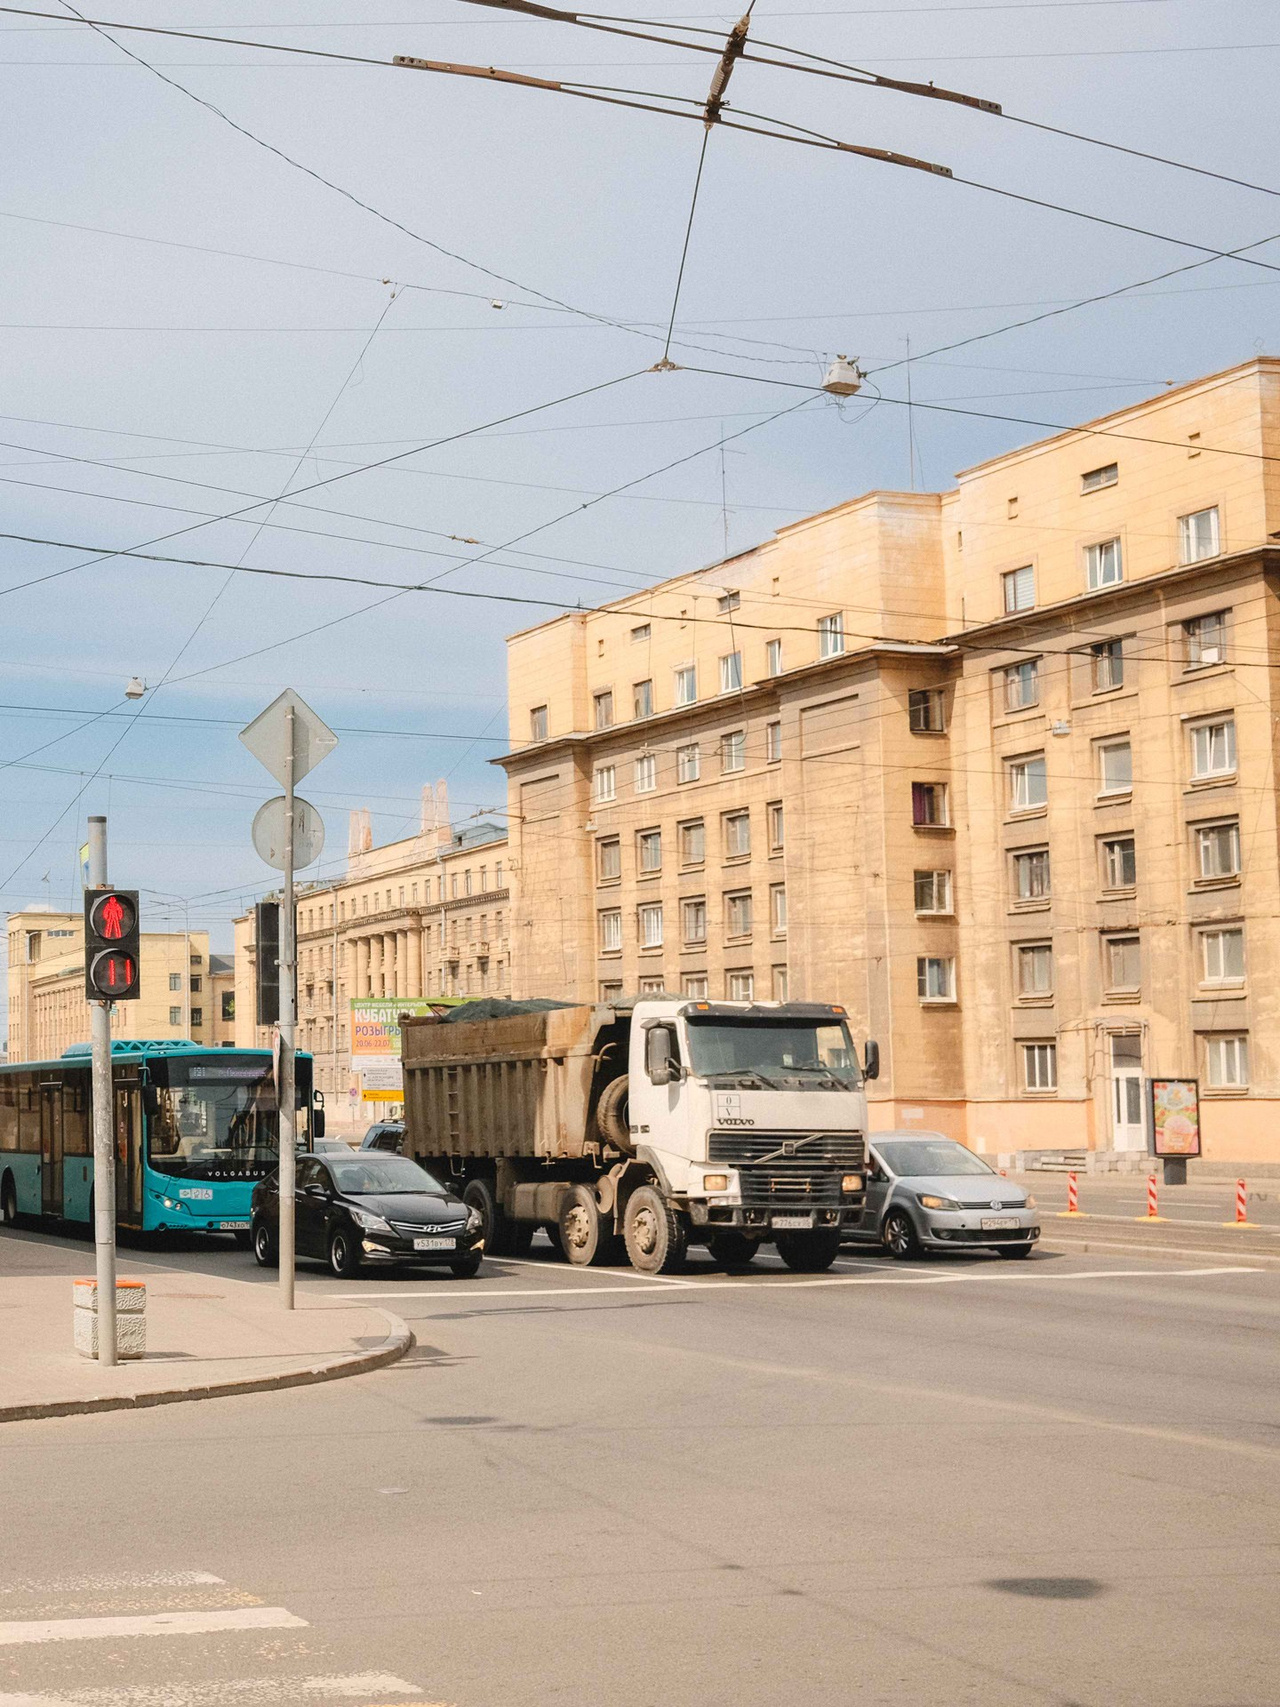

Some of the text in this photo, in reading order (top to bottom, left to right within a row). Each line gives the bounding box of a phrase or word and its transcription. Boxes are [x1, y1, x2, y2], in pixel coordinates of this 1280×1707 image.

[109, 958, 132, 986] 11
[354, 1007, 416, 1023] КУБАТУА
[717, 1118, 755, 1126] VOLVO
